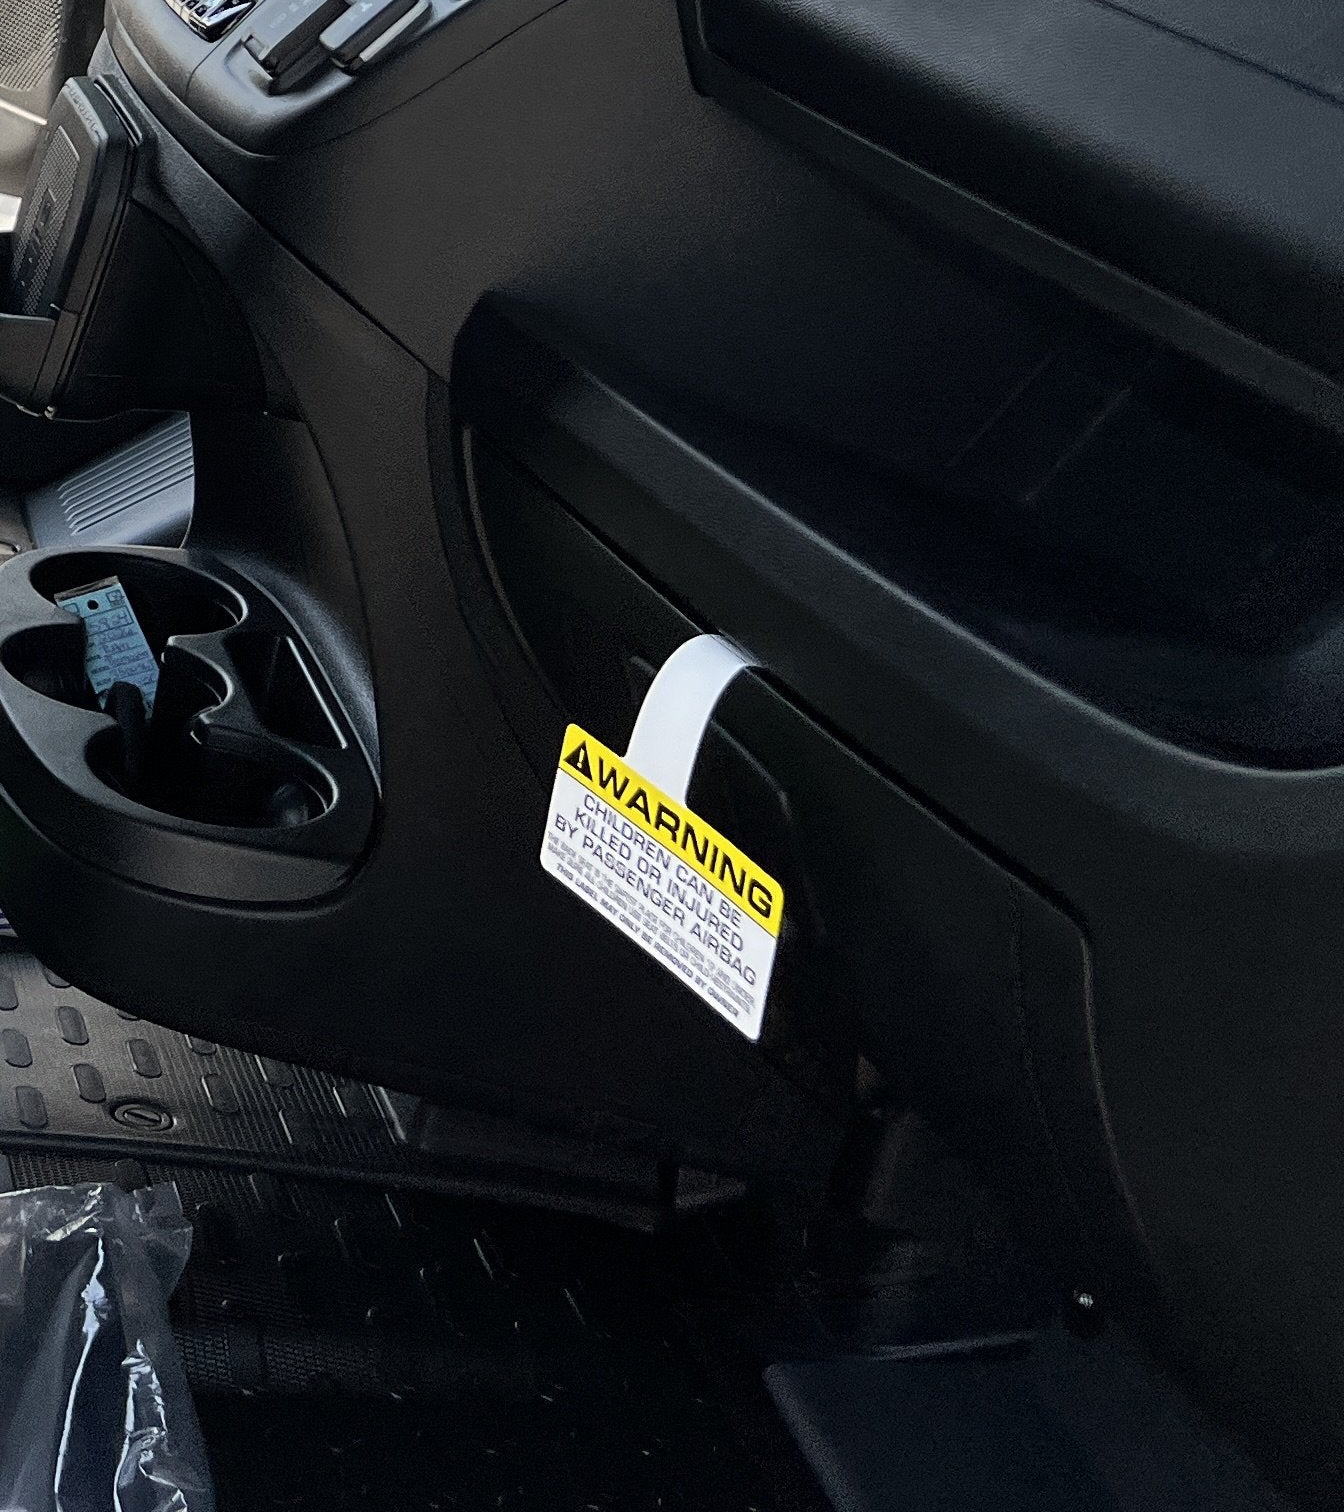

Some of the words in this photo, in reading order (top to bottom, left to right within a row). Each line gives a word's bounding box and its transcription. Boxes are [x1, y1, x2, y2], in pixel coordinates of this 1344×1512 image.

[554, 813, 579, 839] BY
[582, 835, 685, 927] PASSENGER
[689, 922, 756, 986] AIRBAG
[574, 807, 632, 861] KILLED
[636, 856, 662, 886] OR
[667, 878, 744, 952] INJURED
[583, 794, 671, 870] CHILDREN
[675, 864, 714, 905] CAN
[718, 898, 742, 929] BE
[598, 758, 772, 918] WARNING
